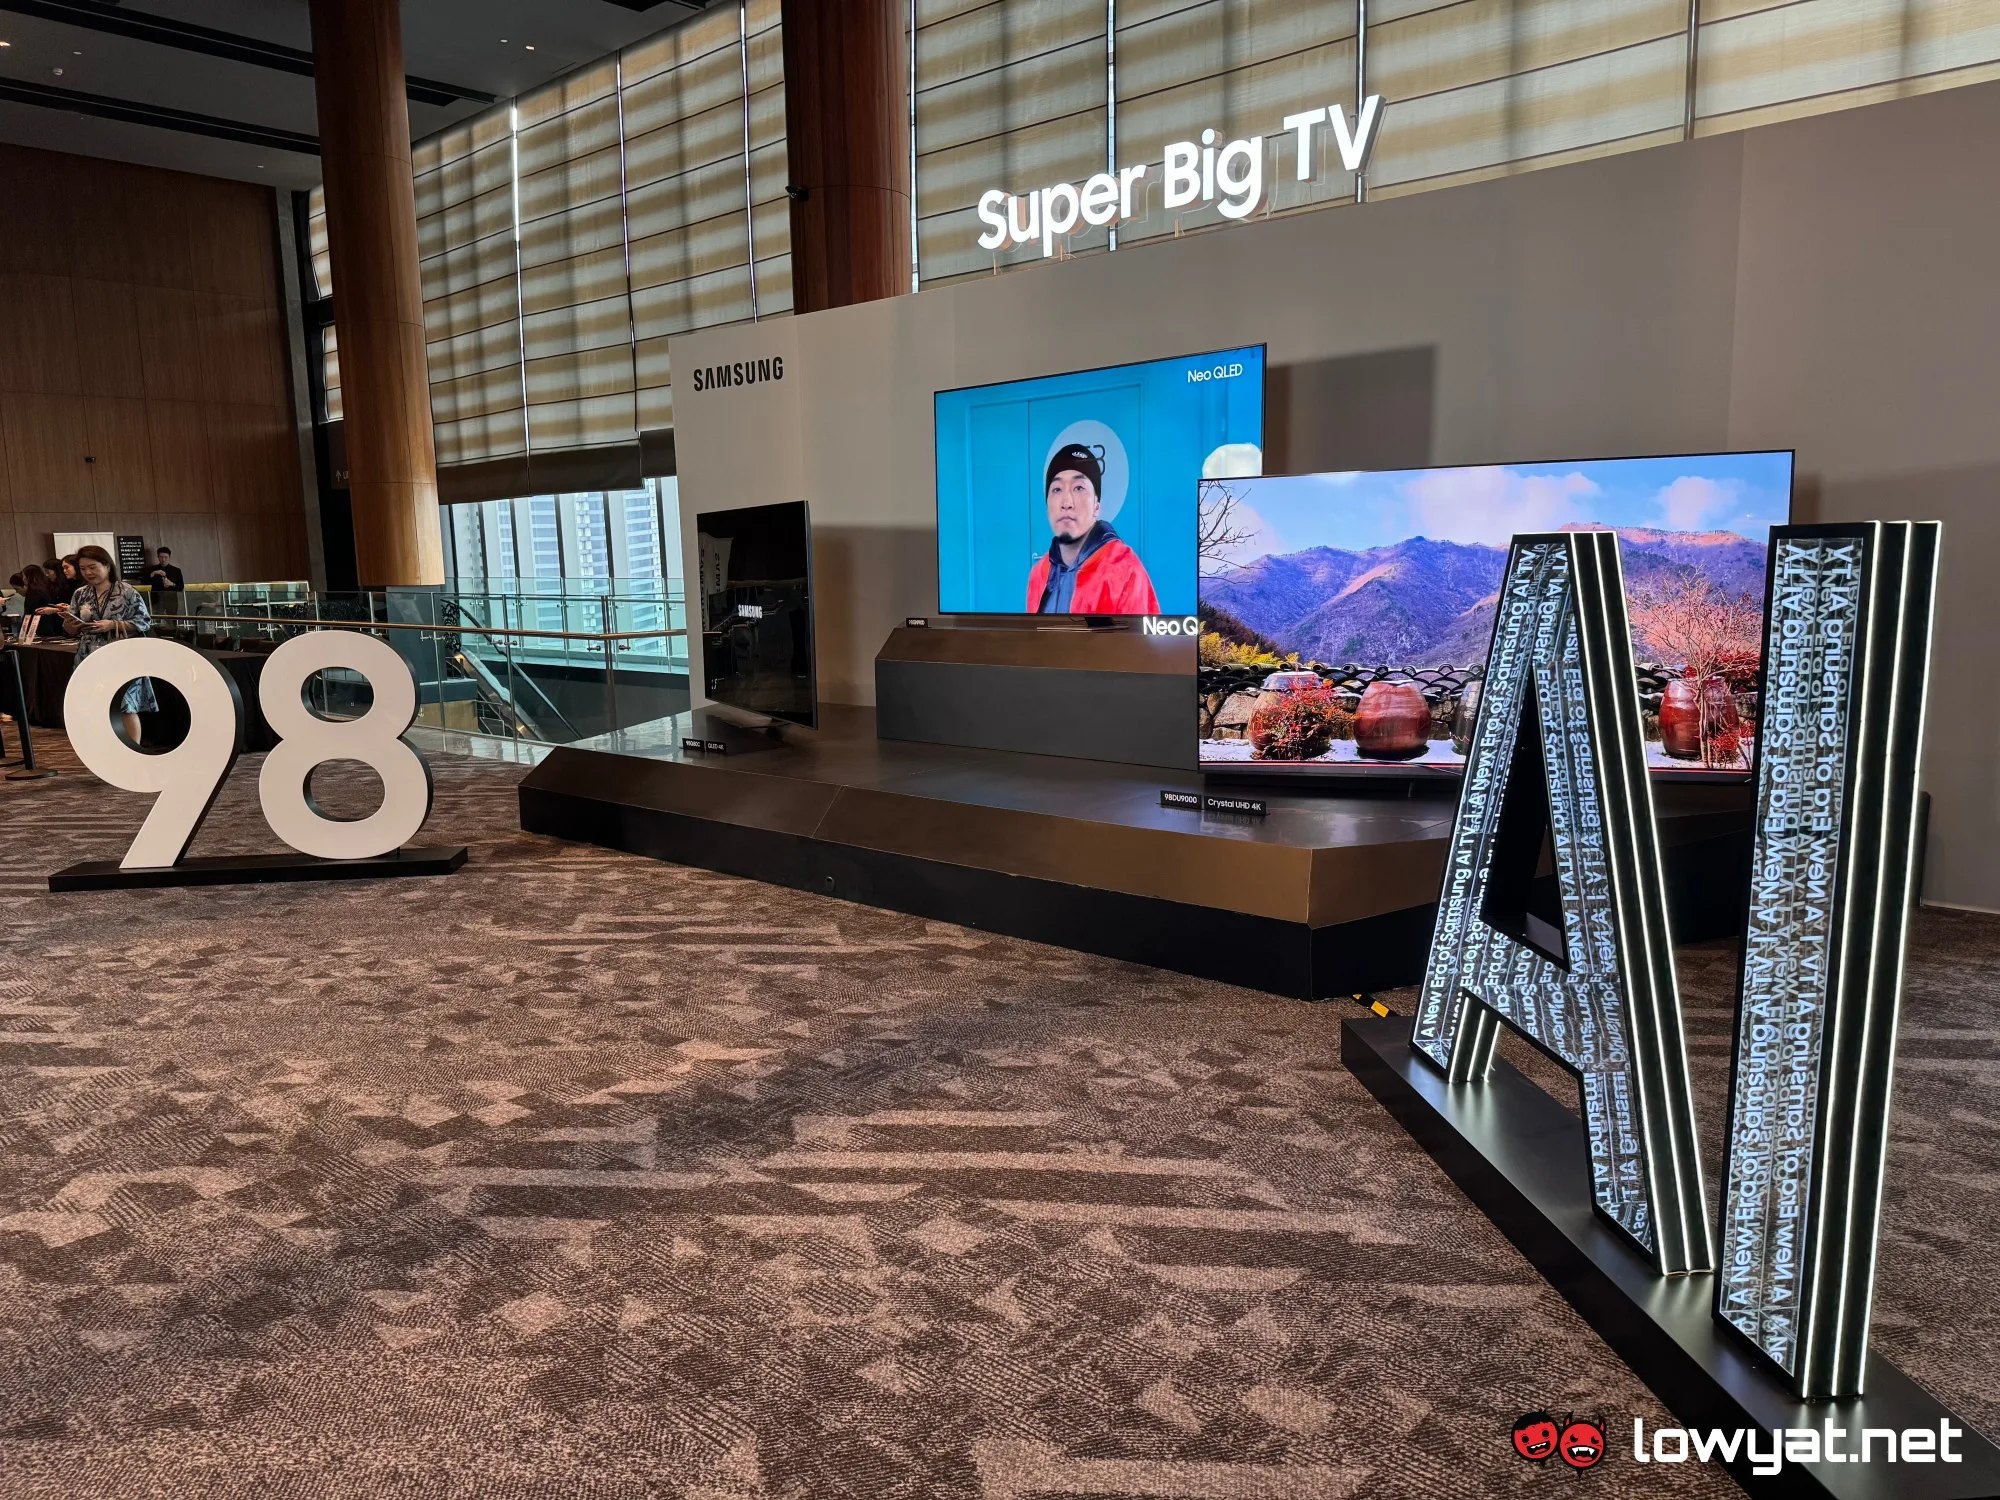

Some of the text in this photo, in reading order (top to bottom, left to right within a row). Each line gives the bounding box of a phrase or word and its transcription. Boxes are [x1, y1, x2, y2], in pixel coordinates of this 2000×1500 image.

[977, 94, 1386, 259] Super Big TV
[693, 356, 784, 392] SAMSUNG
[1187, 363, 1243, 383] Neo QLED
[1516, 548, 1537, 575] TV
[1783, 544, 1806, 579] TV
[1512, 579, 1531, 598] AI
[1781, 586, 1803, 612] AI
[738, 604, 763, 619] SAMSUNG
[1142, 616, 1181, 636] Neo
[1492, 601, 1529, 691] Samsung
[1537, 669, 1551, 703] Era
[1770, 619, 1807, 748] Samsung
[1488, 695, 1505, 714] of
[1480, 718, 1502, 747] Era
[63, 630, 433, 869] 98
[1470, 753, 1493, 791] New
[1768, 754, 1790, 782] of
[1207, 798, 1262, 811] Crystal UHD 4K
[1764, 789, 1787, 832] Era
[1458, 826, 1476, 846] TV
[1455, 850, 1473, 865] AI
[1758, 838, 1783, 899] New
[1439, 868, 1472, 944] Samsung
[1757, 906, 1778, 924] A
[1430, 960, 1449, 988] Era
[1751, 955, 1774, 987] TV
[1424, 991, 1442, 1025] New
[1750, 994, 1771, 1017] AI
[1741, 1025, 1776, 1143] Samsung
[1738, 1149, 1760, 1175] of
[1735, 1181, 1757, 1220] Era
[1730, 1227, 1754, 1283] New
